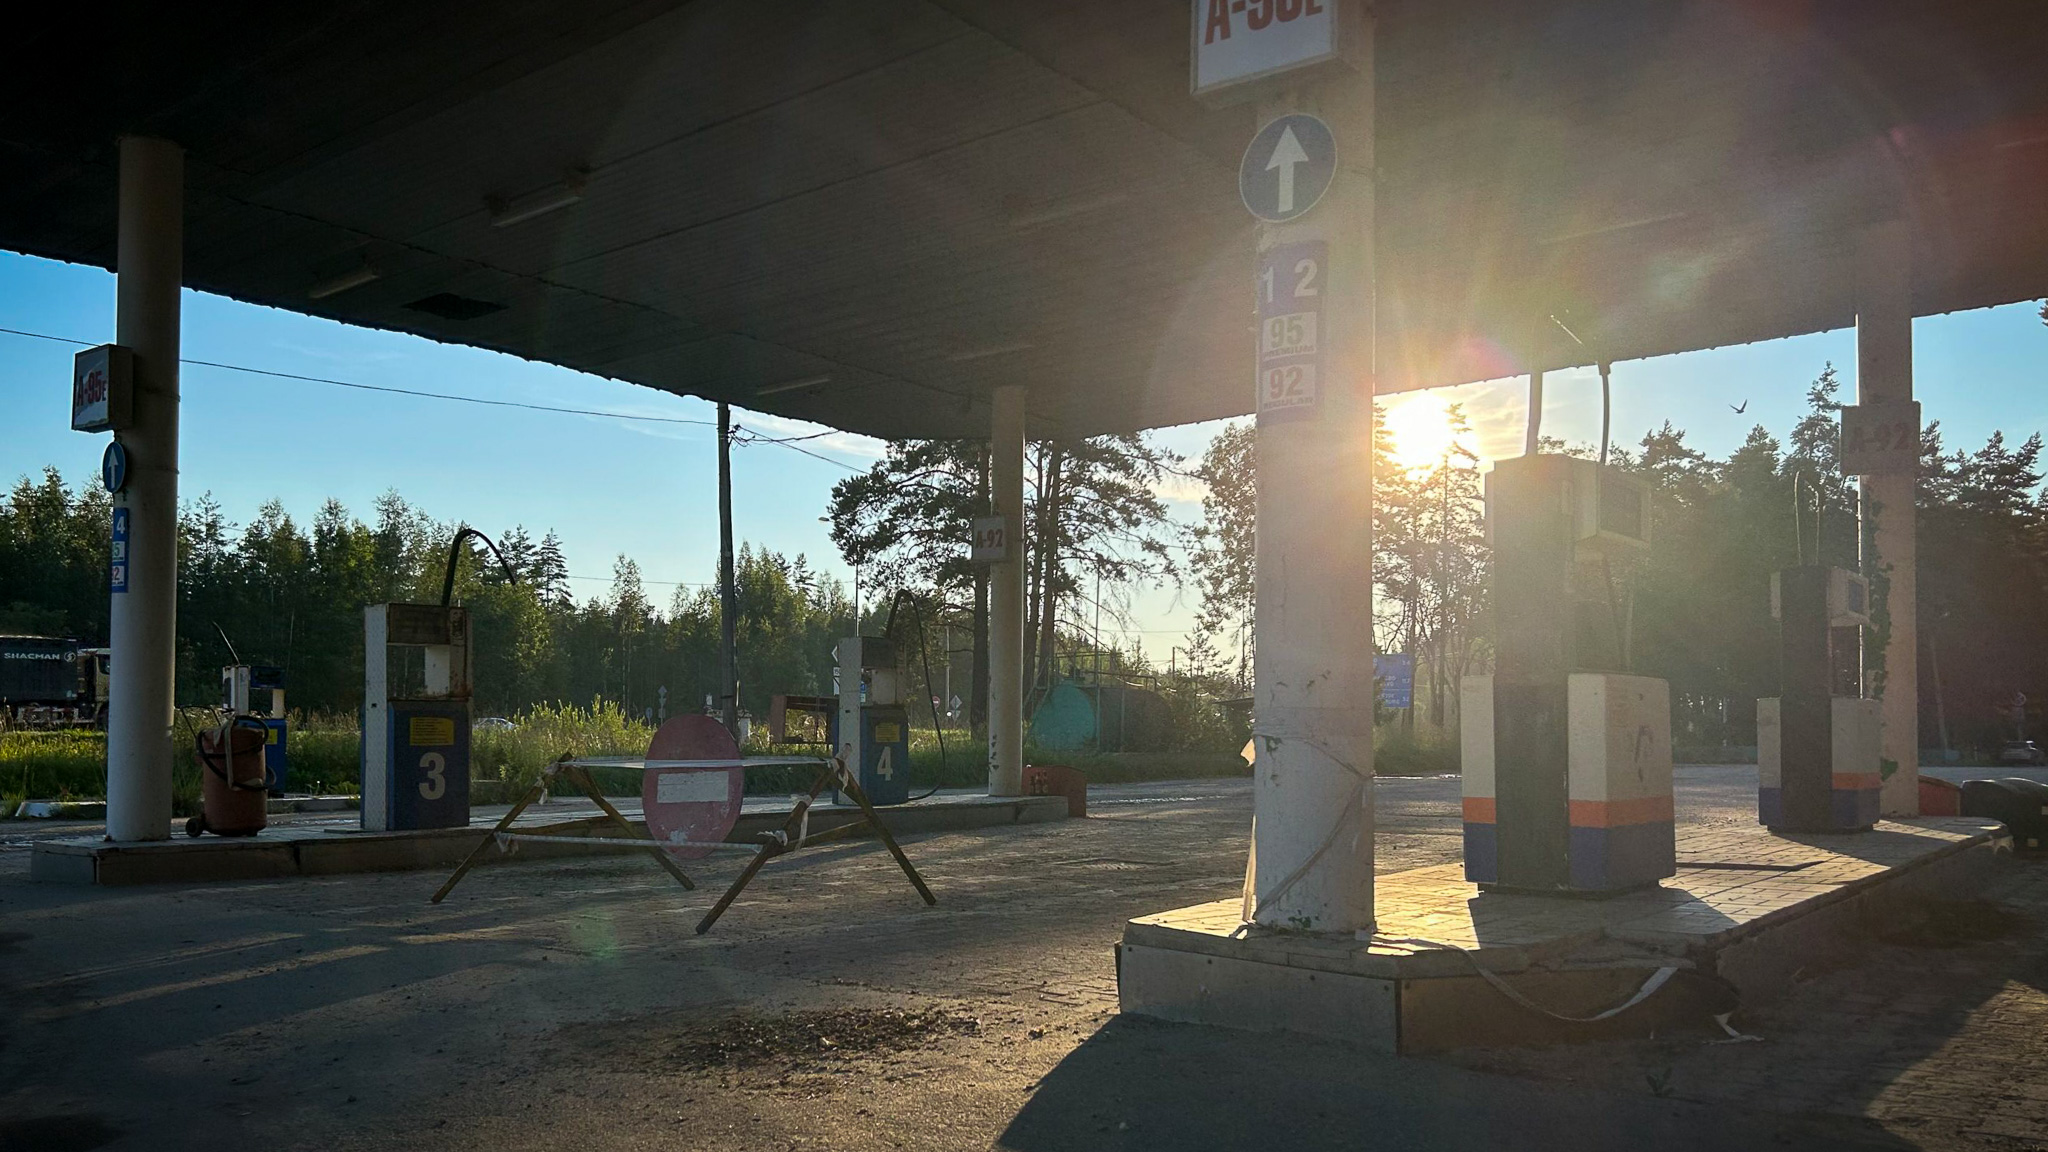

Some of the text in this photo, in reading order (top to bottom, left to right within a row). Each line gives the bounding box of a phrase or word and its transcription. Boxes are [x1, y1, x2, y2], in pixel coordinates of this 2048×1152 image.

[1262, 258, 1318, 304] 1 2
[1270, 314, 1304, 349] 95
[1270, 366, 1303, 400] 92
[116, 515, 126, 535] 4
[4, 652, 60, 660] SHACMAN
[418, 751, 446, 801] 3
[876, 745, 894, 782] 4
